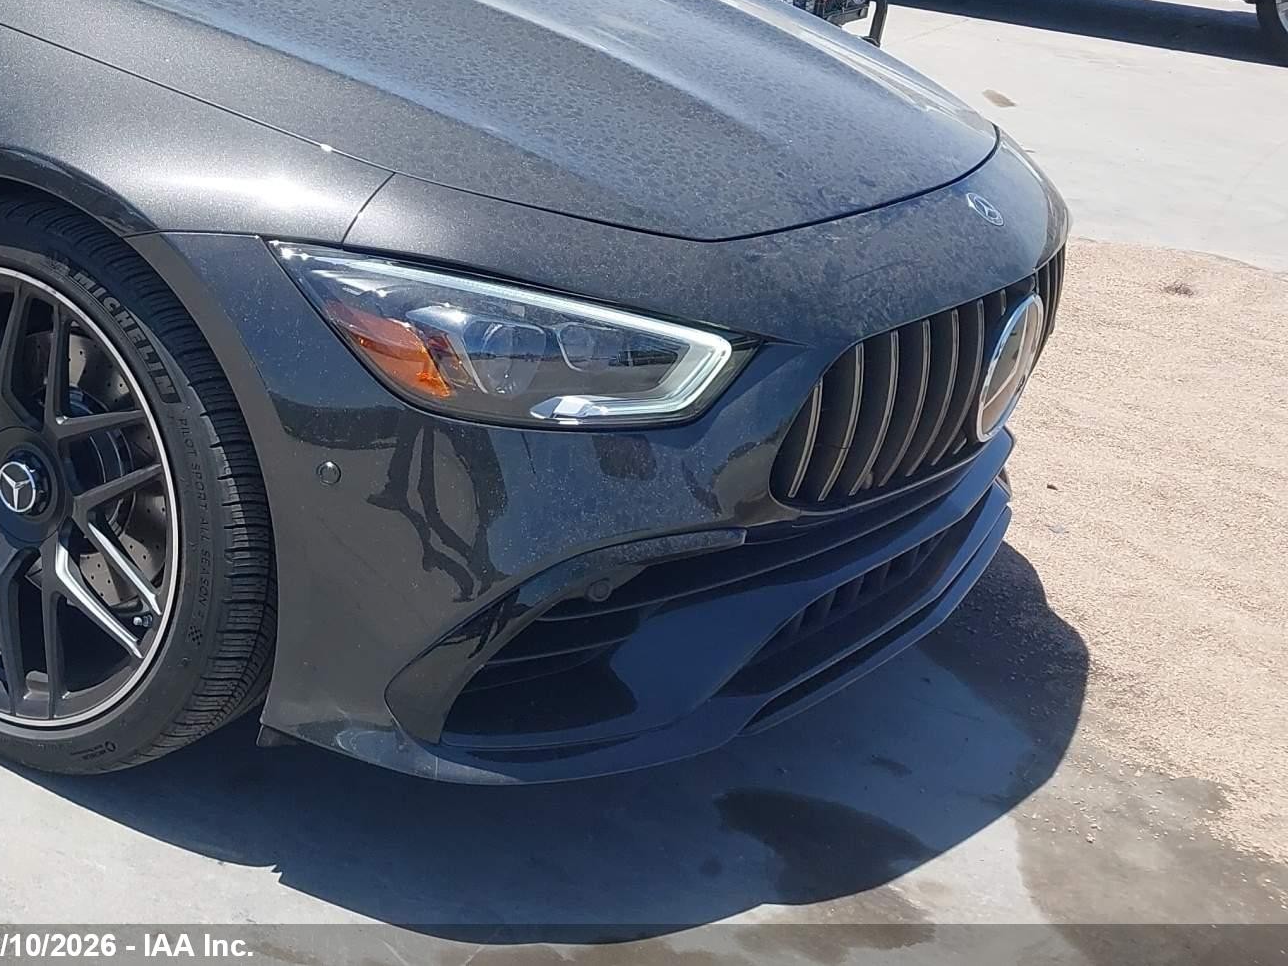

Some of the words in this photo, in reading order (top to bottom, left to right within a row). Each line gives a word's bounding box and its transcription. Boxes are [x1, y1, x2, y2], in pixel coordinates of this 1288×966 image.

[73, 272, 182, 404] MICHELIN
[177, 418, 198, 457] PILOT
[192, 463, 209, 512] SPORT
